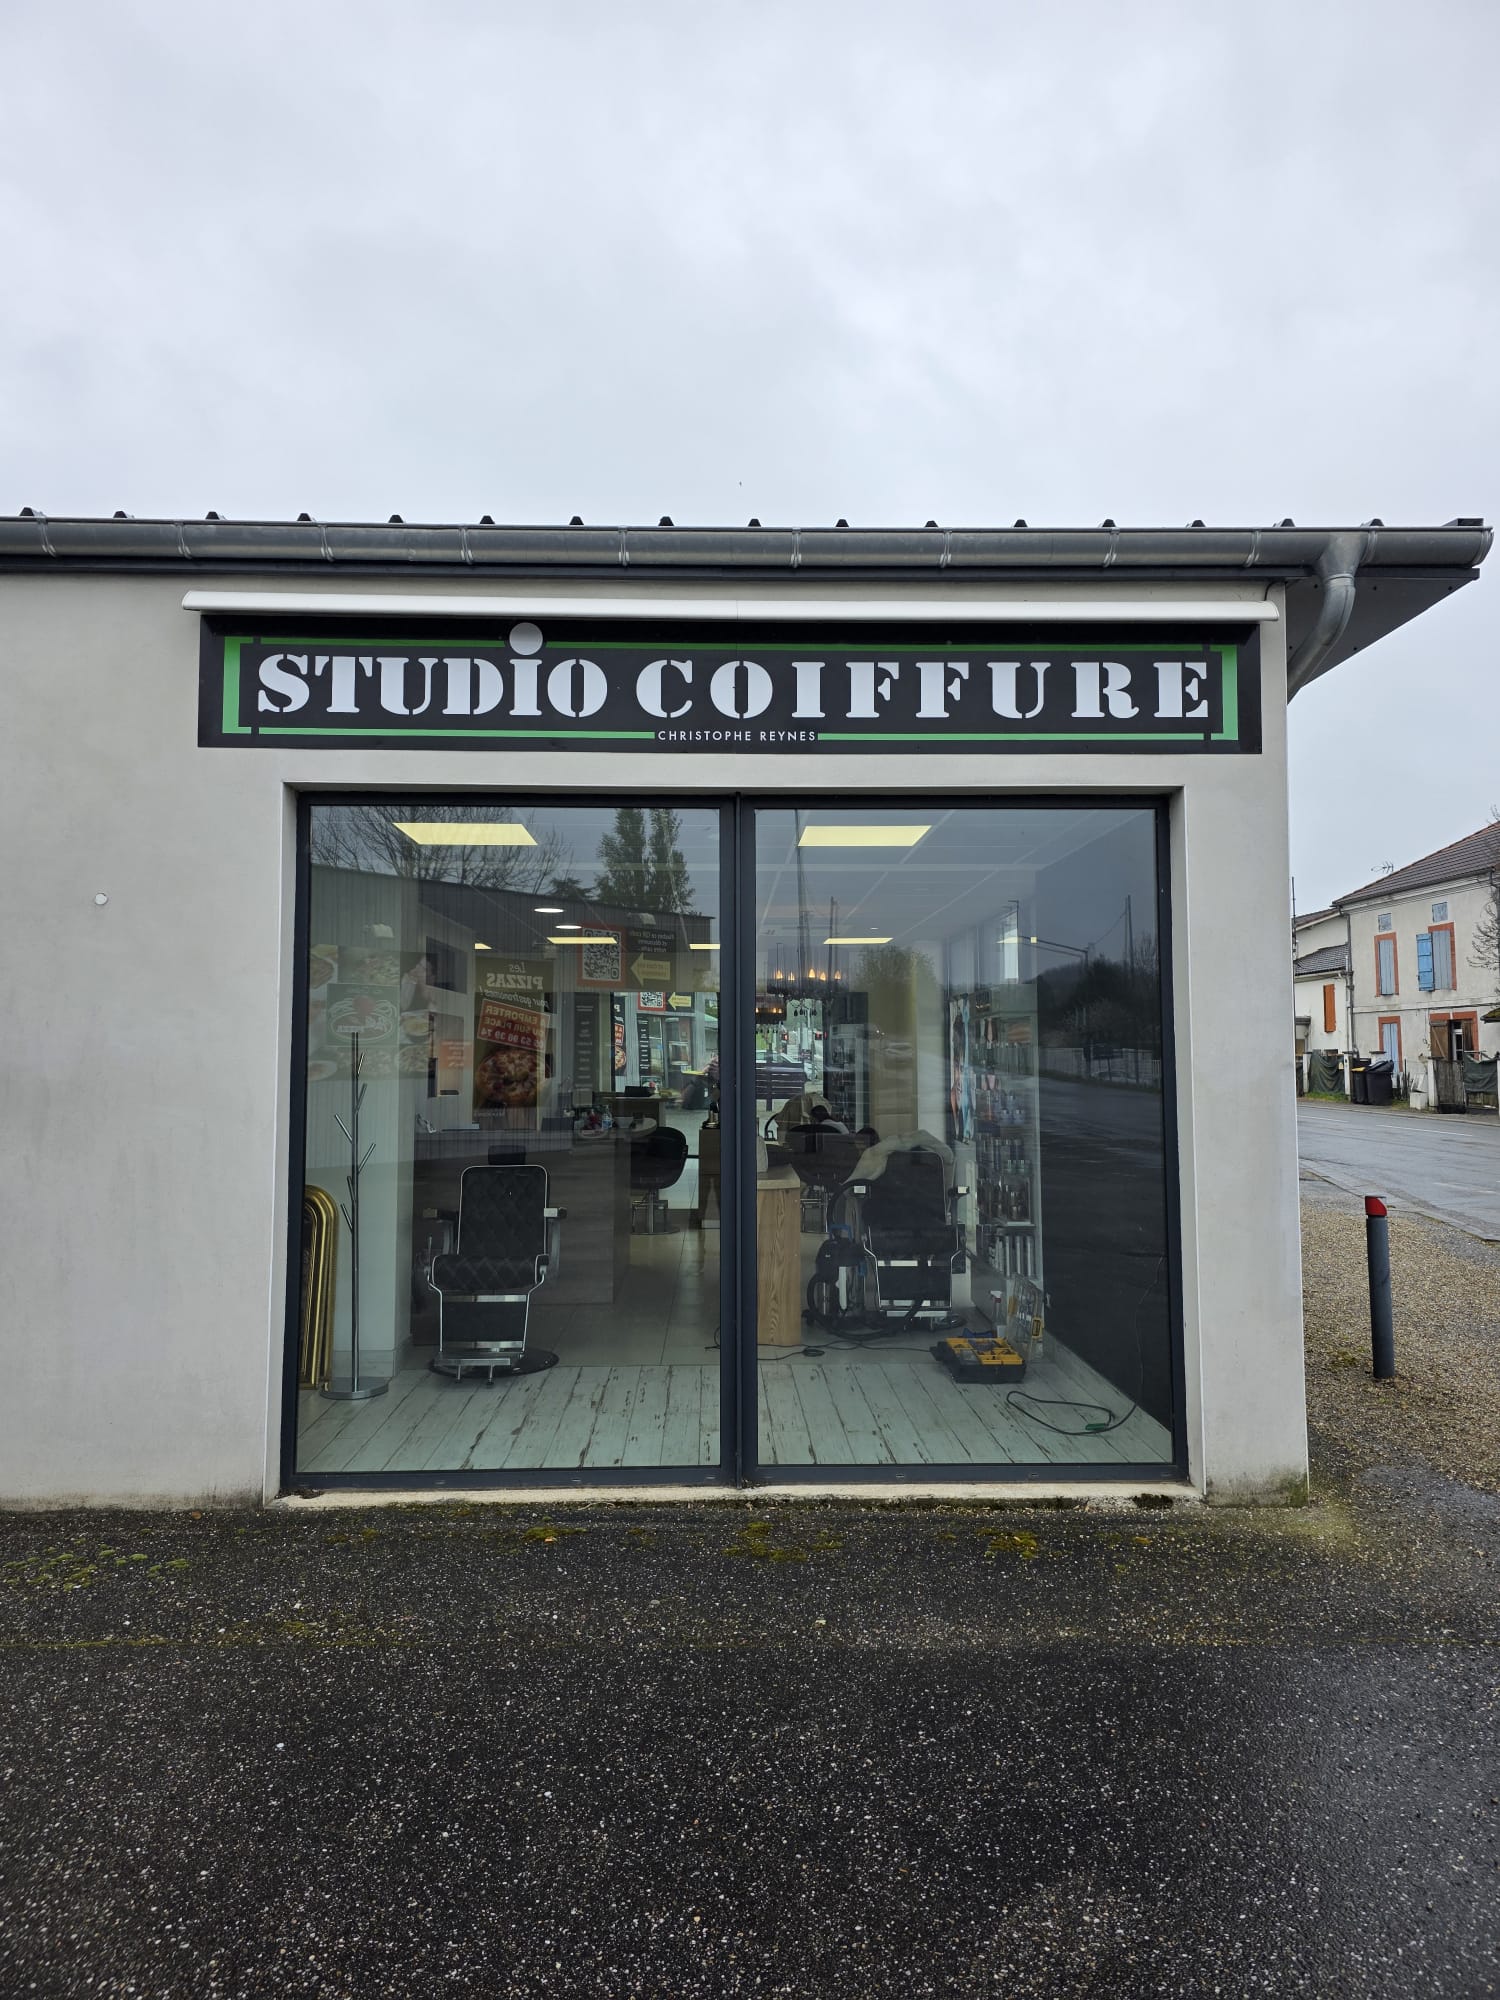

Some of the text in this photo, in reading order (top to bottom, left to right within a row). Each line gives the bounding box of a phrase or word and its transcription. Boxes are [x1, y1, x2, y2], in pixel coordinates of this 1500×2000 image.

[636, 659, 1209, 719] COIFFURE
[657, 730, 816, 742] CHRISTOPHE REYNES
